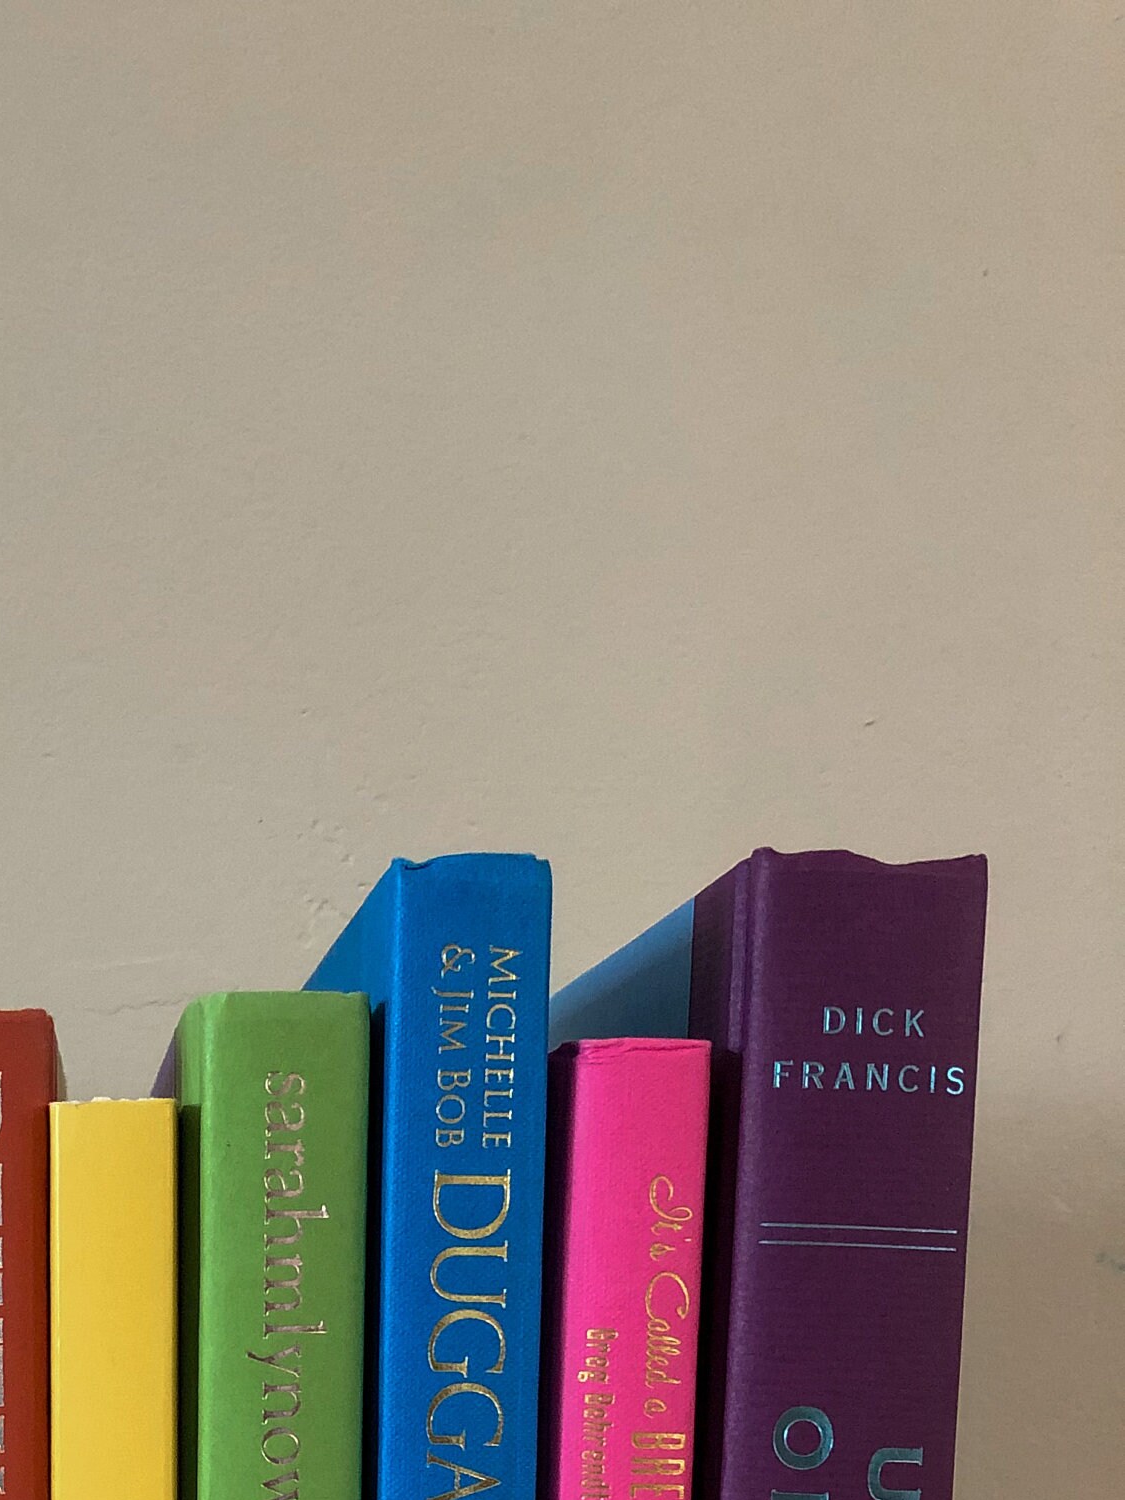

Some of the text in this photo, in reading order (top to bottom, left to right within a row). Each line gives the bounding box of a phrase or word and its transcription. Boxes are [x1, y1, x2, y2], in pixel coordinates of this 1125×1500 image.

[431, 943, 476, 1149] & JIM BOB
[481, 945, 522, 1149] MICHELLE
[821, 1006, 926, 1038] DICK
[772, 1061, 967, 1095] FRANCIS
[577, 1327, 620, 1383] Greg
[644, 1271, 690, 1388] Called
[579, 1392, 616, 1500] Behrendt
